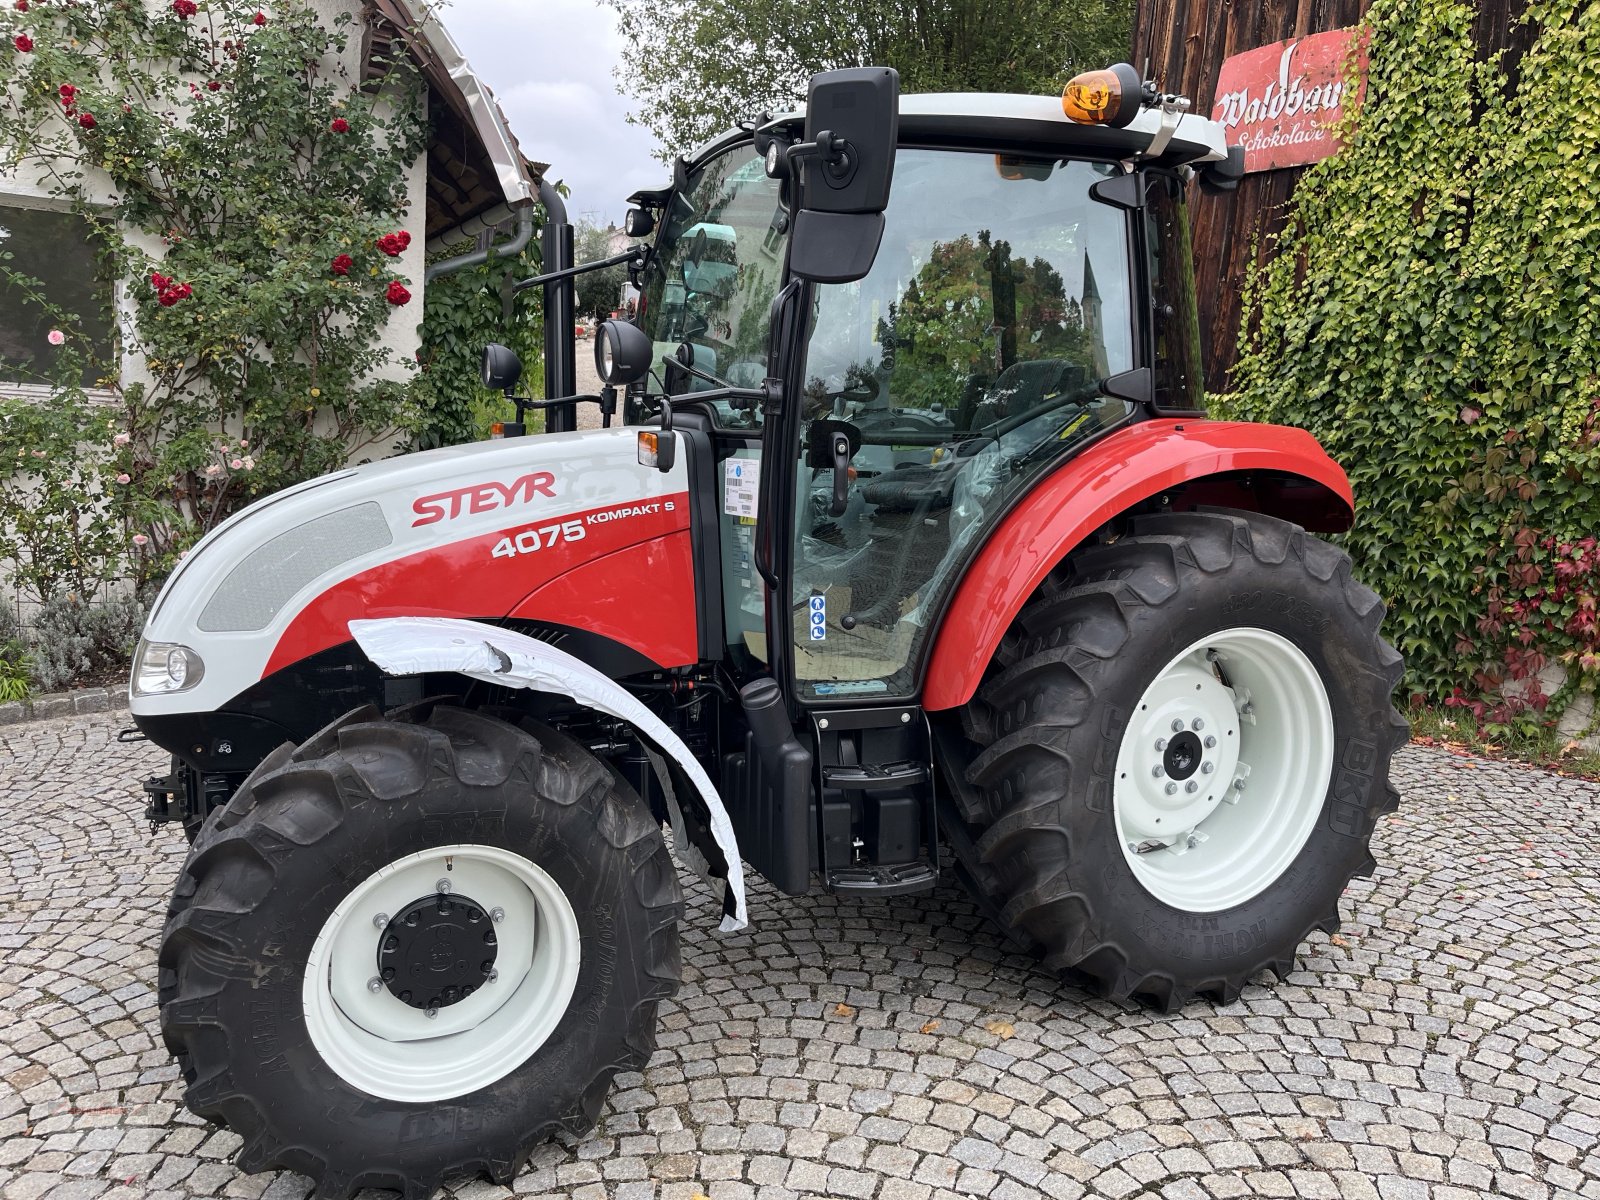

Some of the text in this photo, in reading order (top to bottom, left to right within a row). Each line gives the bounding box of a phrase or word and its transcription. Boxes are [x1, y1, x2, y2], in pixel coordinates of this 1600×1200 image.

[1217, 43, 1352, 130] Waldbau
[411, 471, 557, 528] STEYR
[491, 501, 675, 560] 4075 KOMPAKT S
[1328, 736, 1377, 838] BKT
